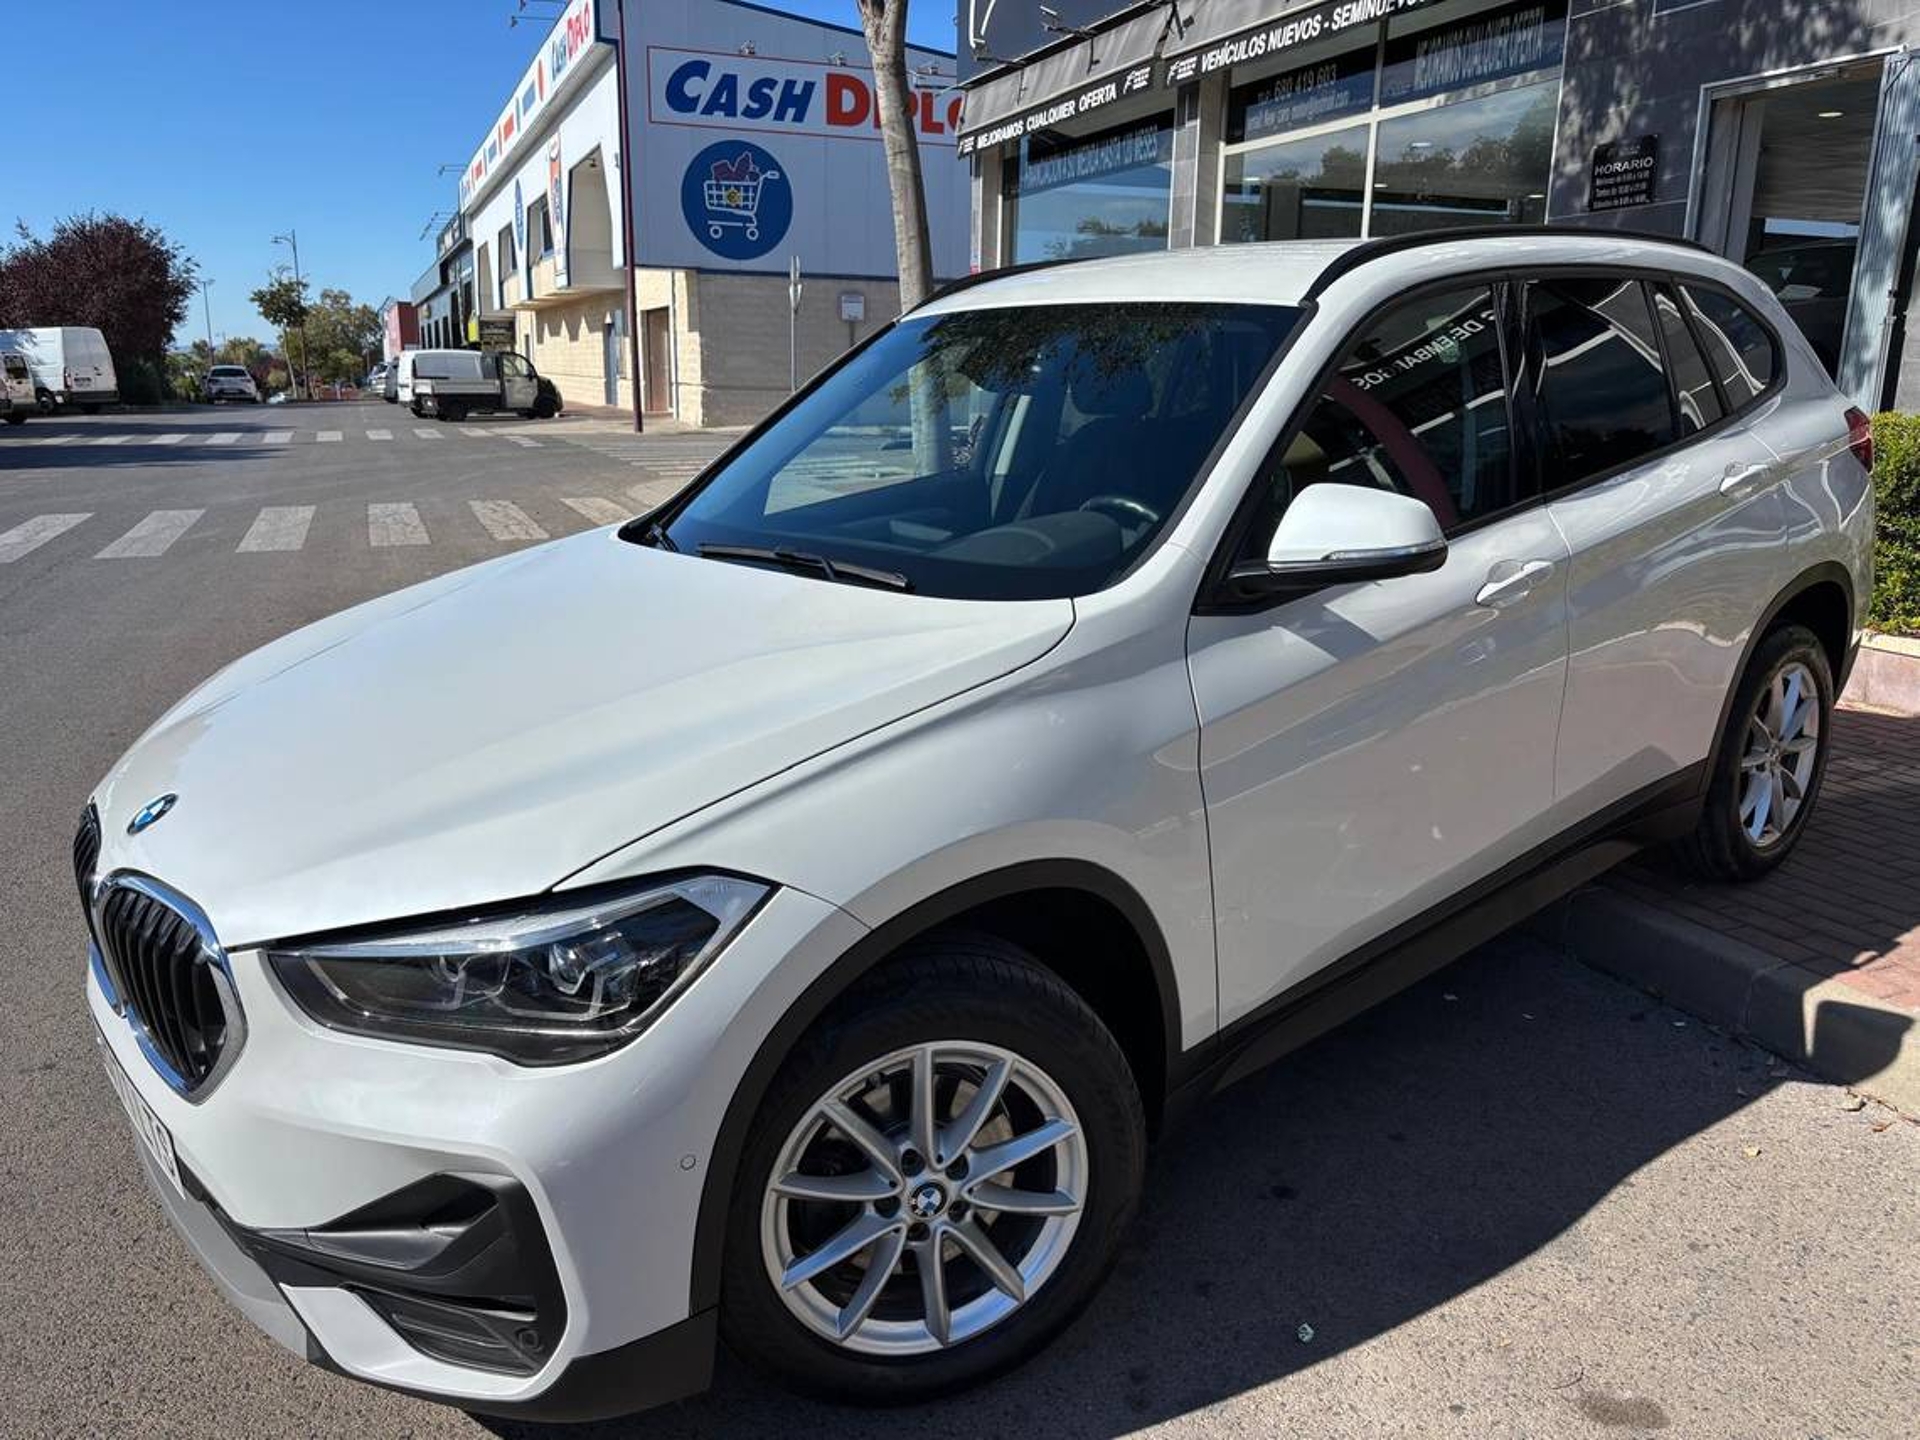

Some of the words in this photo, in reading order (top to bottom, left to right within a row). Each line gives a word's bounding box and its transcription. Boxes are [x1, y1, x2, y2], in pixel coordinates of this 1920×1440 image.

[1200, 34, 1266, 73] VEHÍCULOS
[1267, 16, 1322, 52] NUEVOS
[1332, 0, 1424, 30] SEMINUE
[665, 60, 816, 122] CASH
[977, 117, 1024, 149] MEJORAMOS
[1026, 97, 1076, 131] CUALQUIER
[1078, 82, 1117, 111] OFERTA
[1595, 157, 1653, 176] HORARIO
